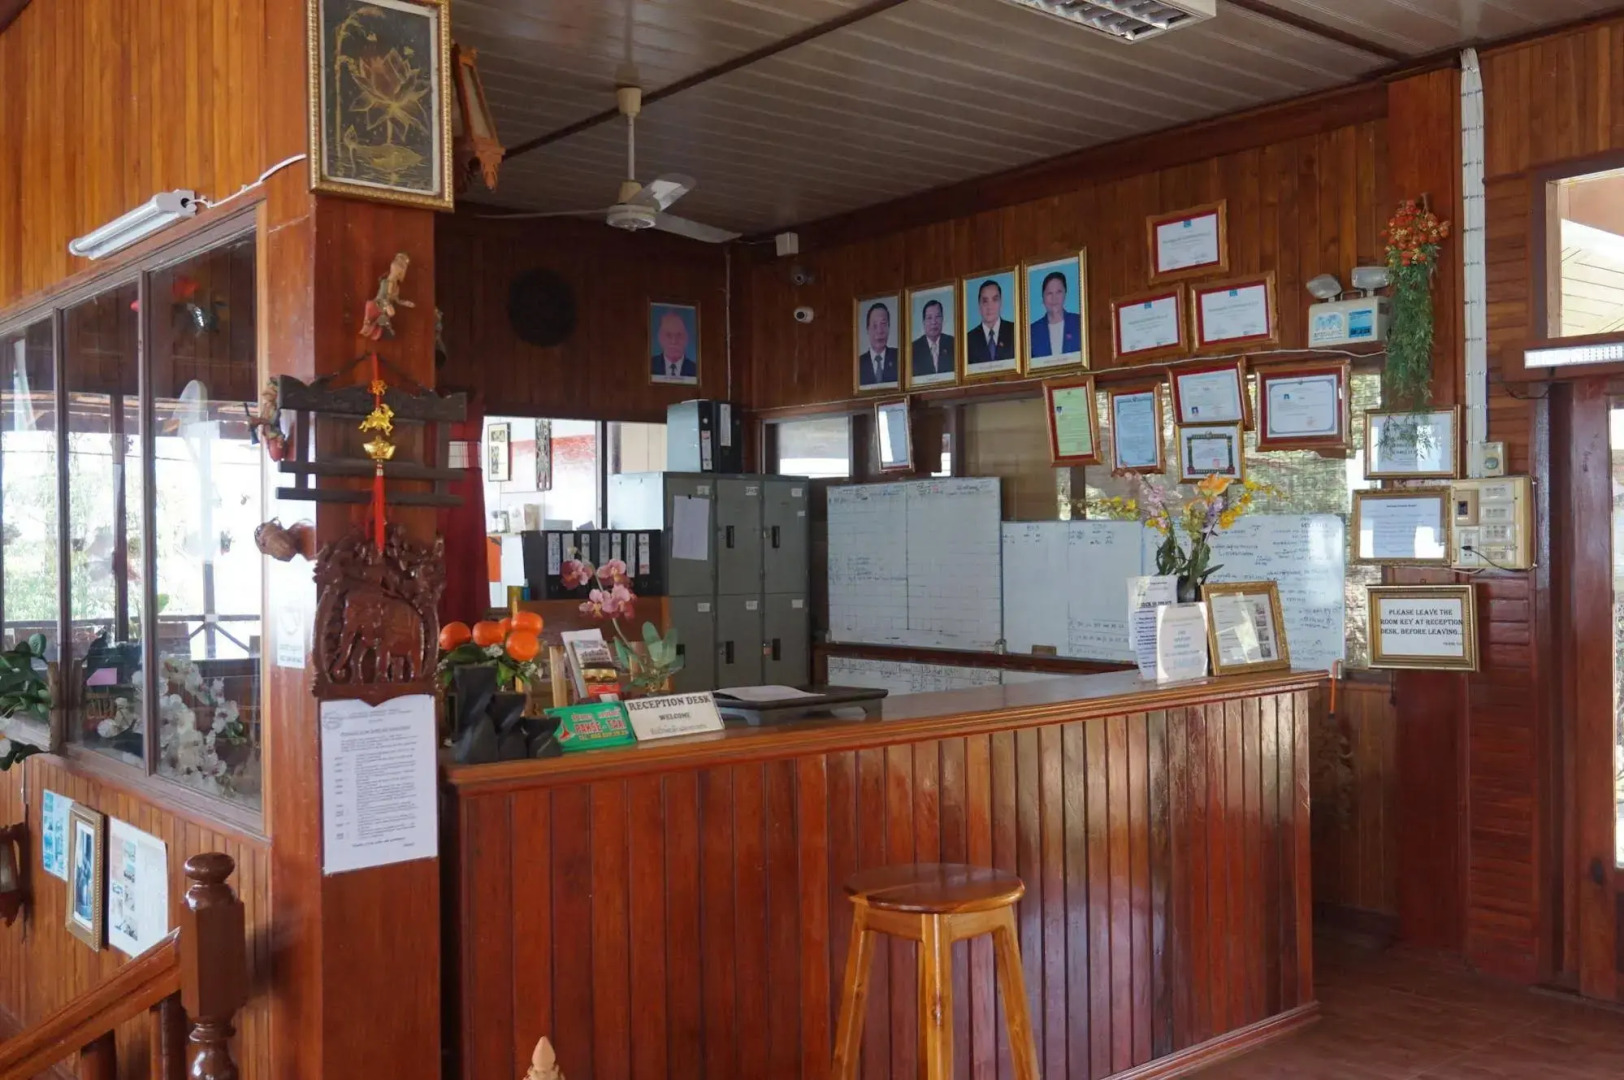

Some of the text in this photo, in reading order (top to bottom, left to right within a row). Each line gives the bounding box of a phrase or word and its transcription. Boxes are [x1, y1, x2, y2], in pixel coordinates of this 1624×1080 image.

[628, 694, 711, 711] RECEPTION DESK
[659, 712, 690, 721] WELCOME
